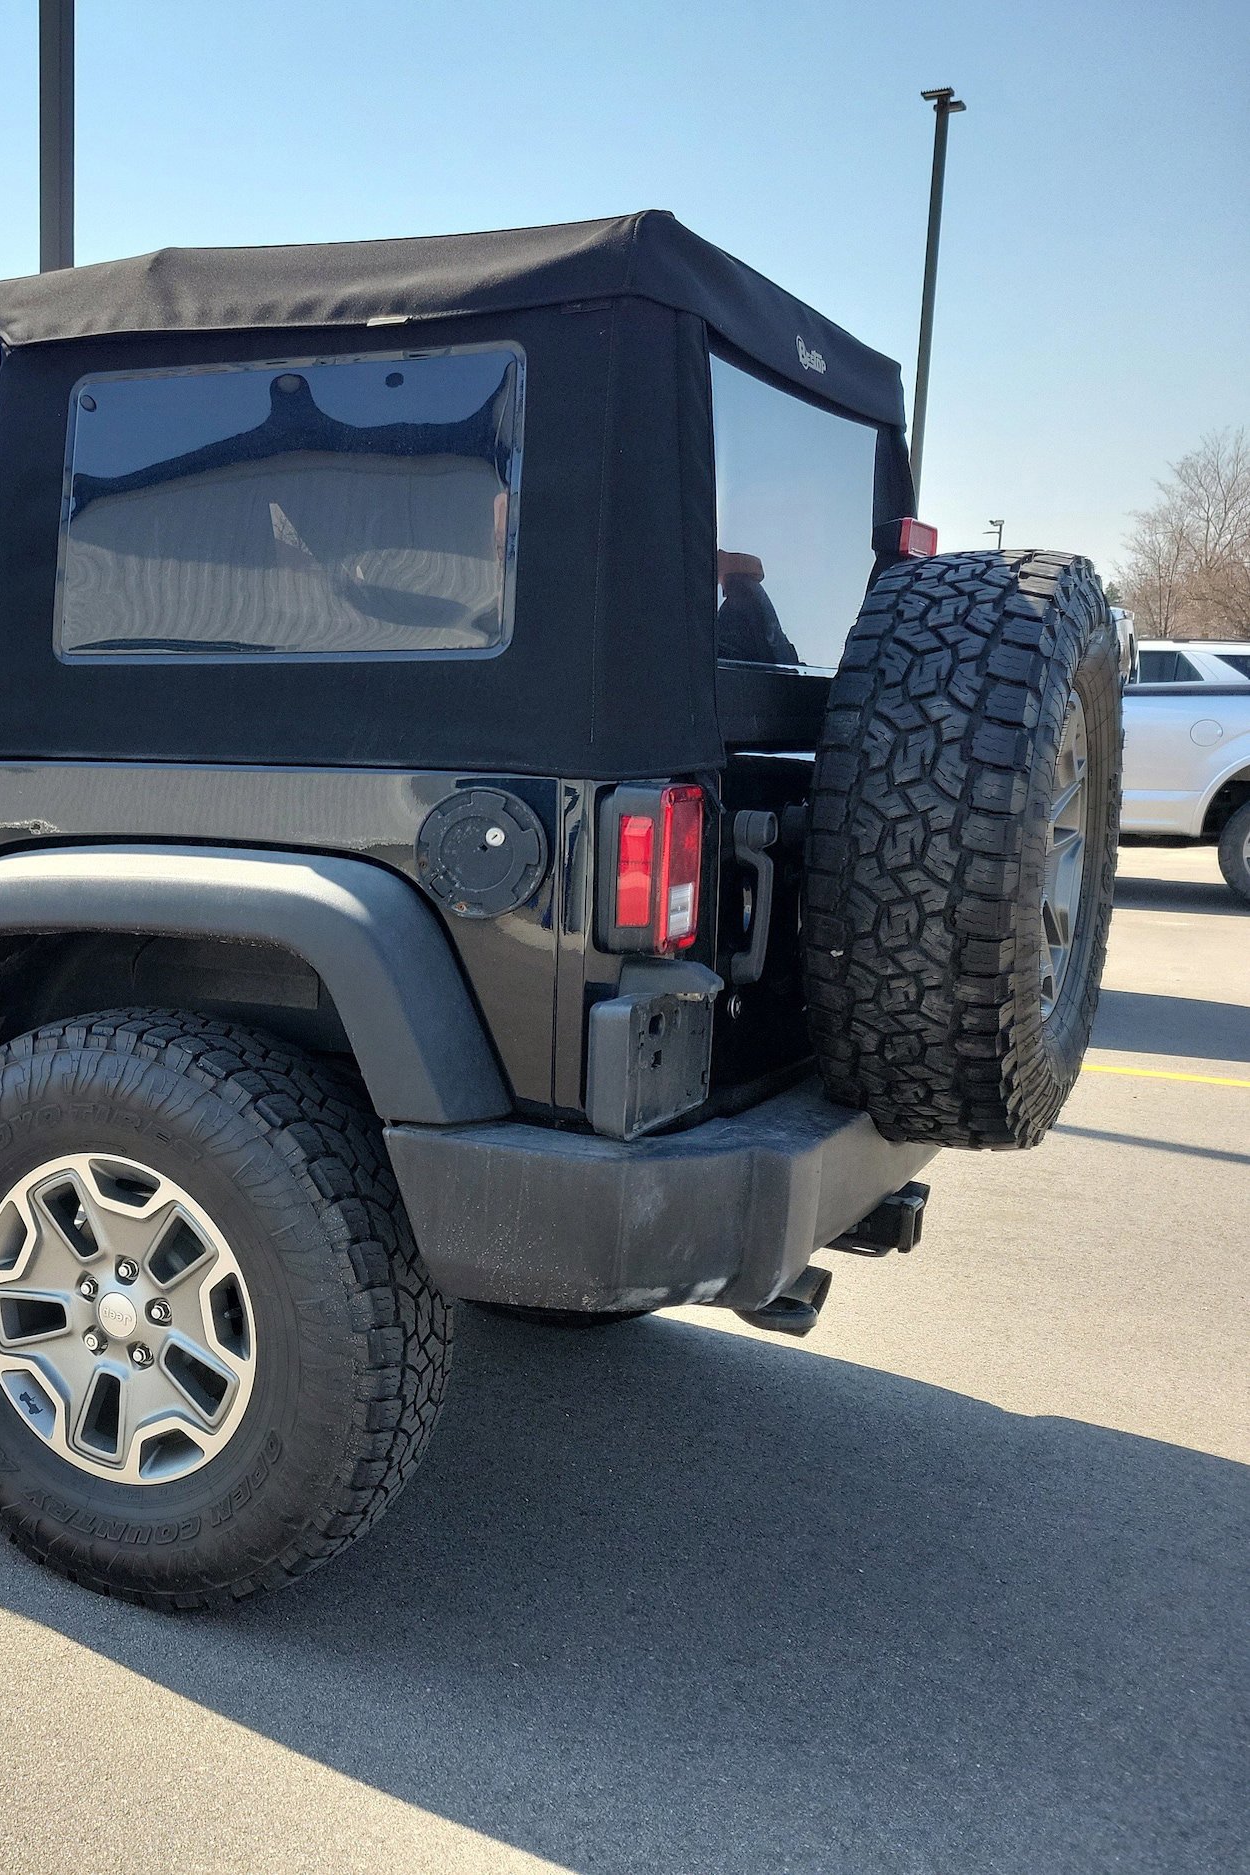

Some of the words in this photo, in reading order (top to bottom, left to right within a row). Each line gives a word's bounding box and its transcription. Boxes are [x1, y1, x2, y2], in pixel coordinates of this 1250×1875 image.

[102, 1306, 133, 1326] Jeep
[211, 1429, 283, 1528] OPEN
[22, 1488, 202, 1546] COUNTRY
